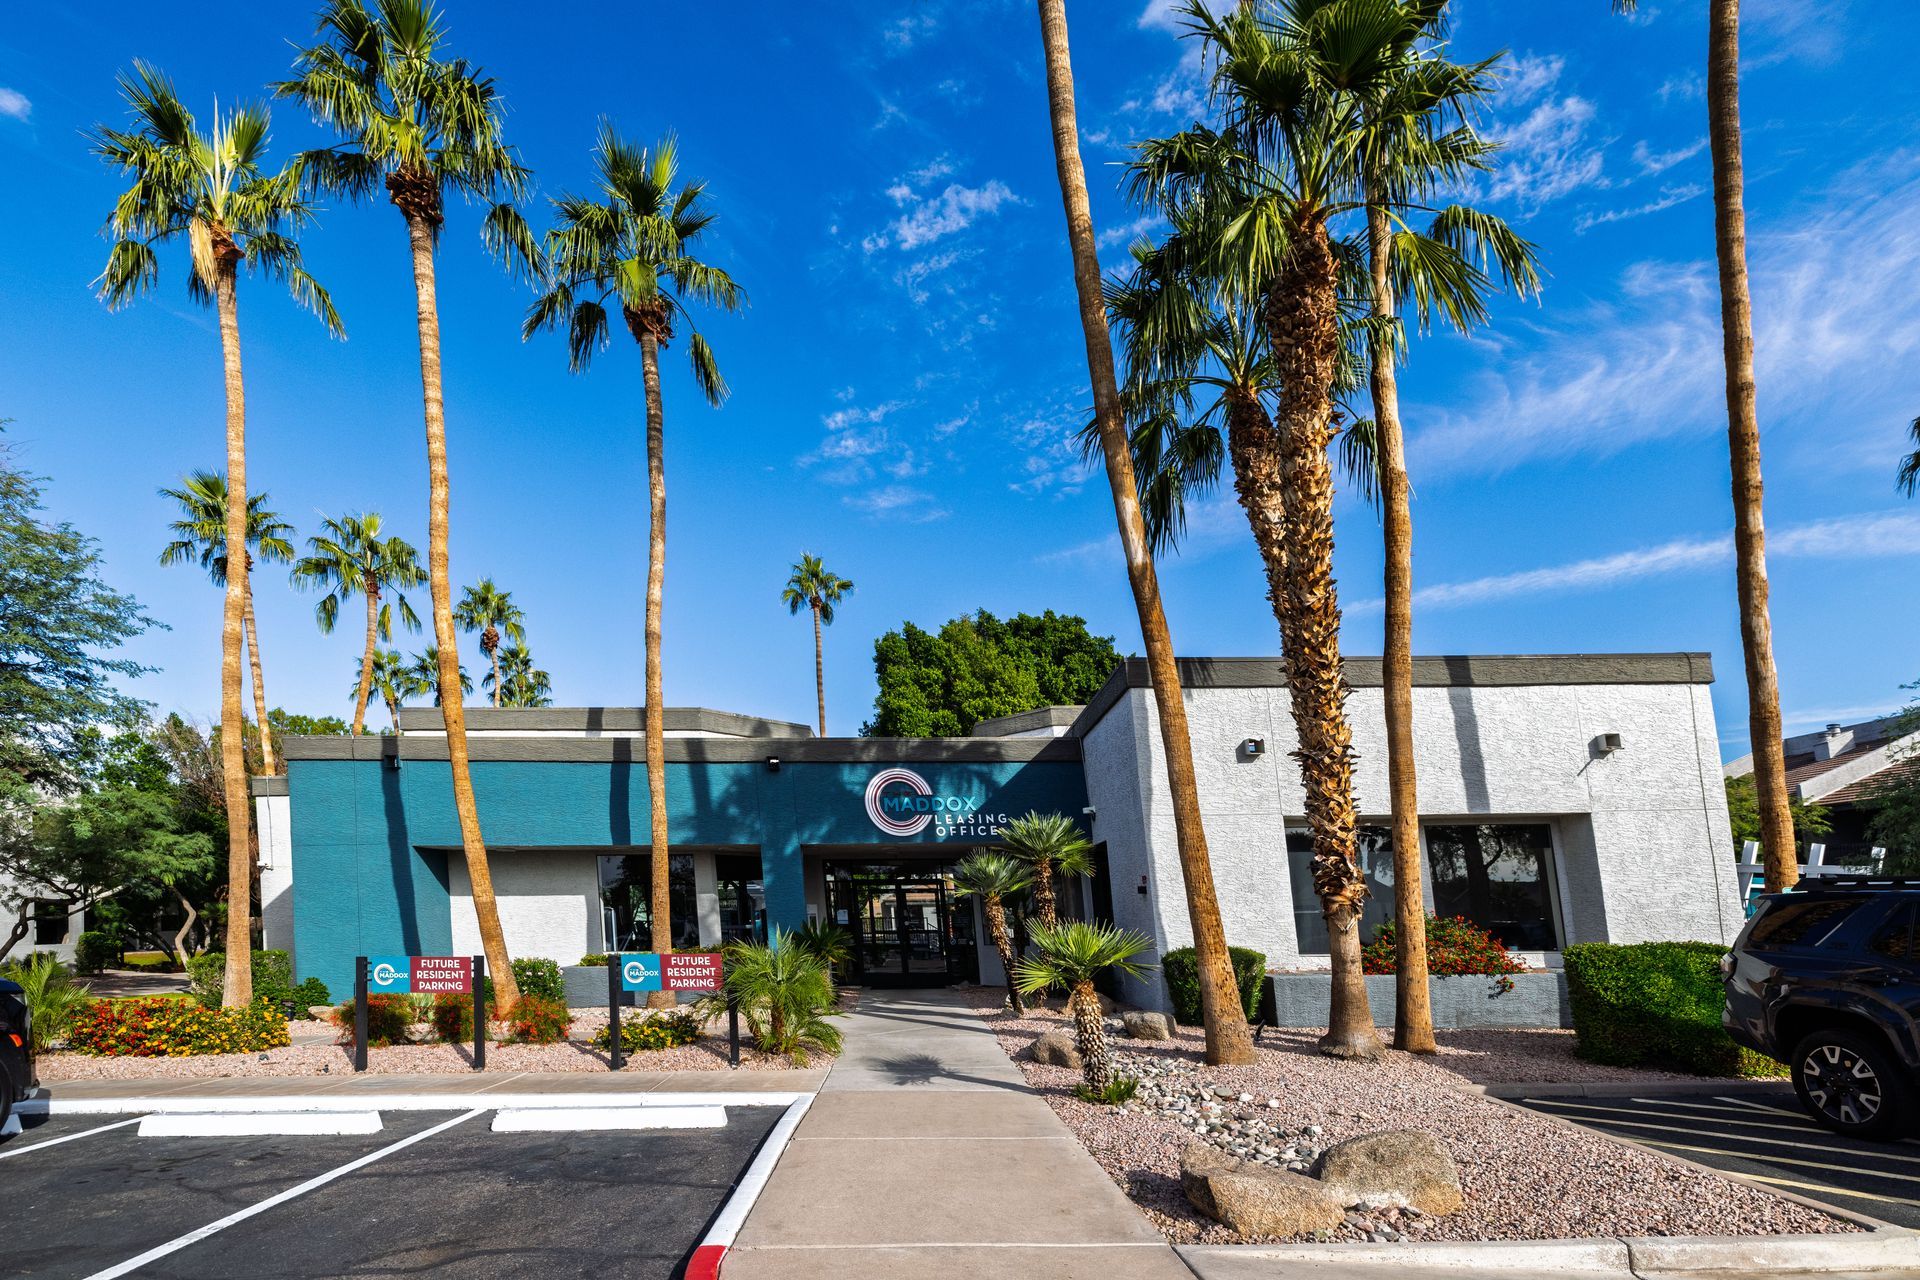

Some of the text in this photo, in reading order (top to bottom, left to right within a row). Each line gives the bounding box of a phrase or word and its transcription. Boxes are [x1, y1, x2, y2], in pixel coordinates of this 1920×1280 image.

[883, 796, 977, 812] MADDOX
[935, 813, 1007, 825] LEASING
[936, 826, 998, 836] OFFICE
[421, 959, 460, 968] FUTURE
[671, 956, 710, 965] FUTURE
[416, 970, 465, 979] RESIDENT
[667, 967, 716, 976] RESIDENT
[419, 981, 463, 990] PARKING
[670, 978, 715, 987] PARKING
